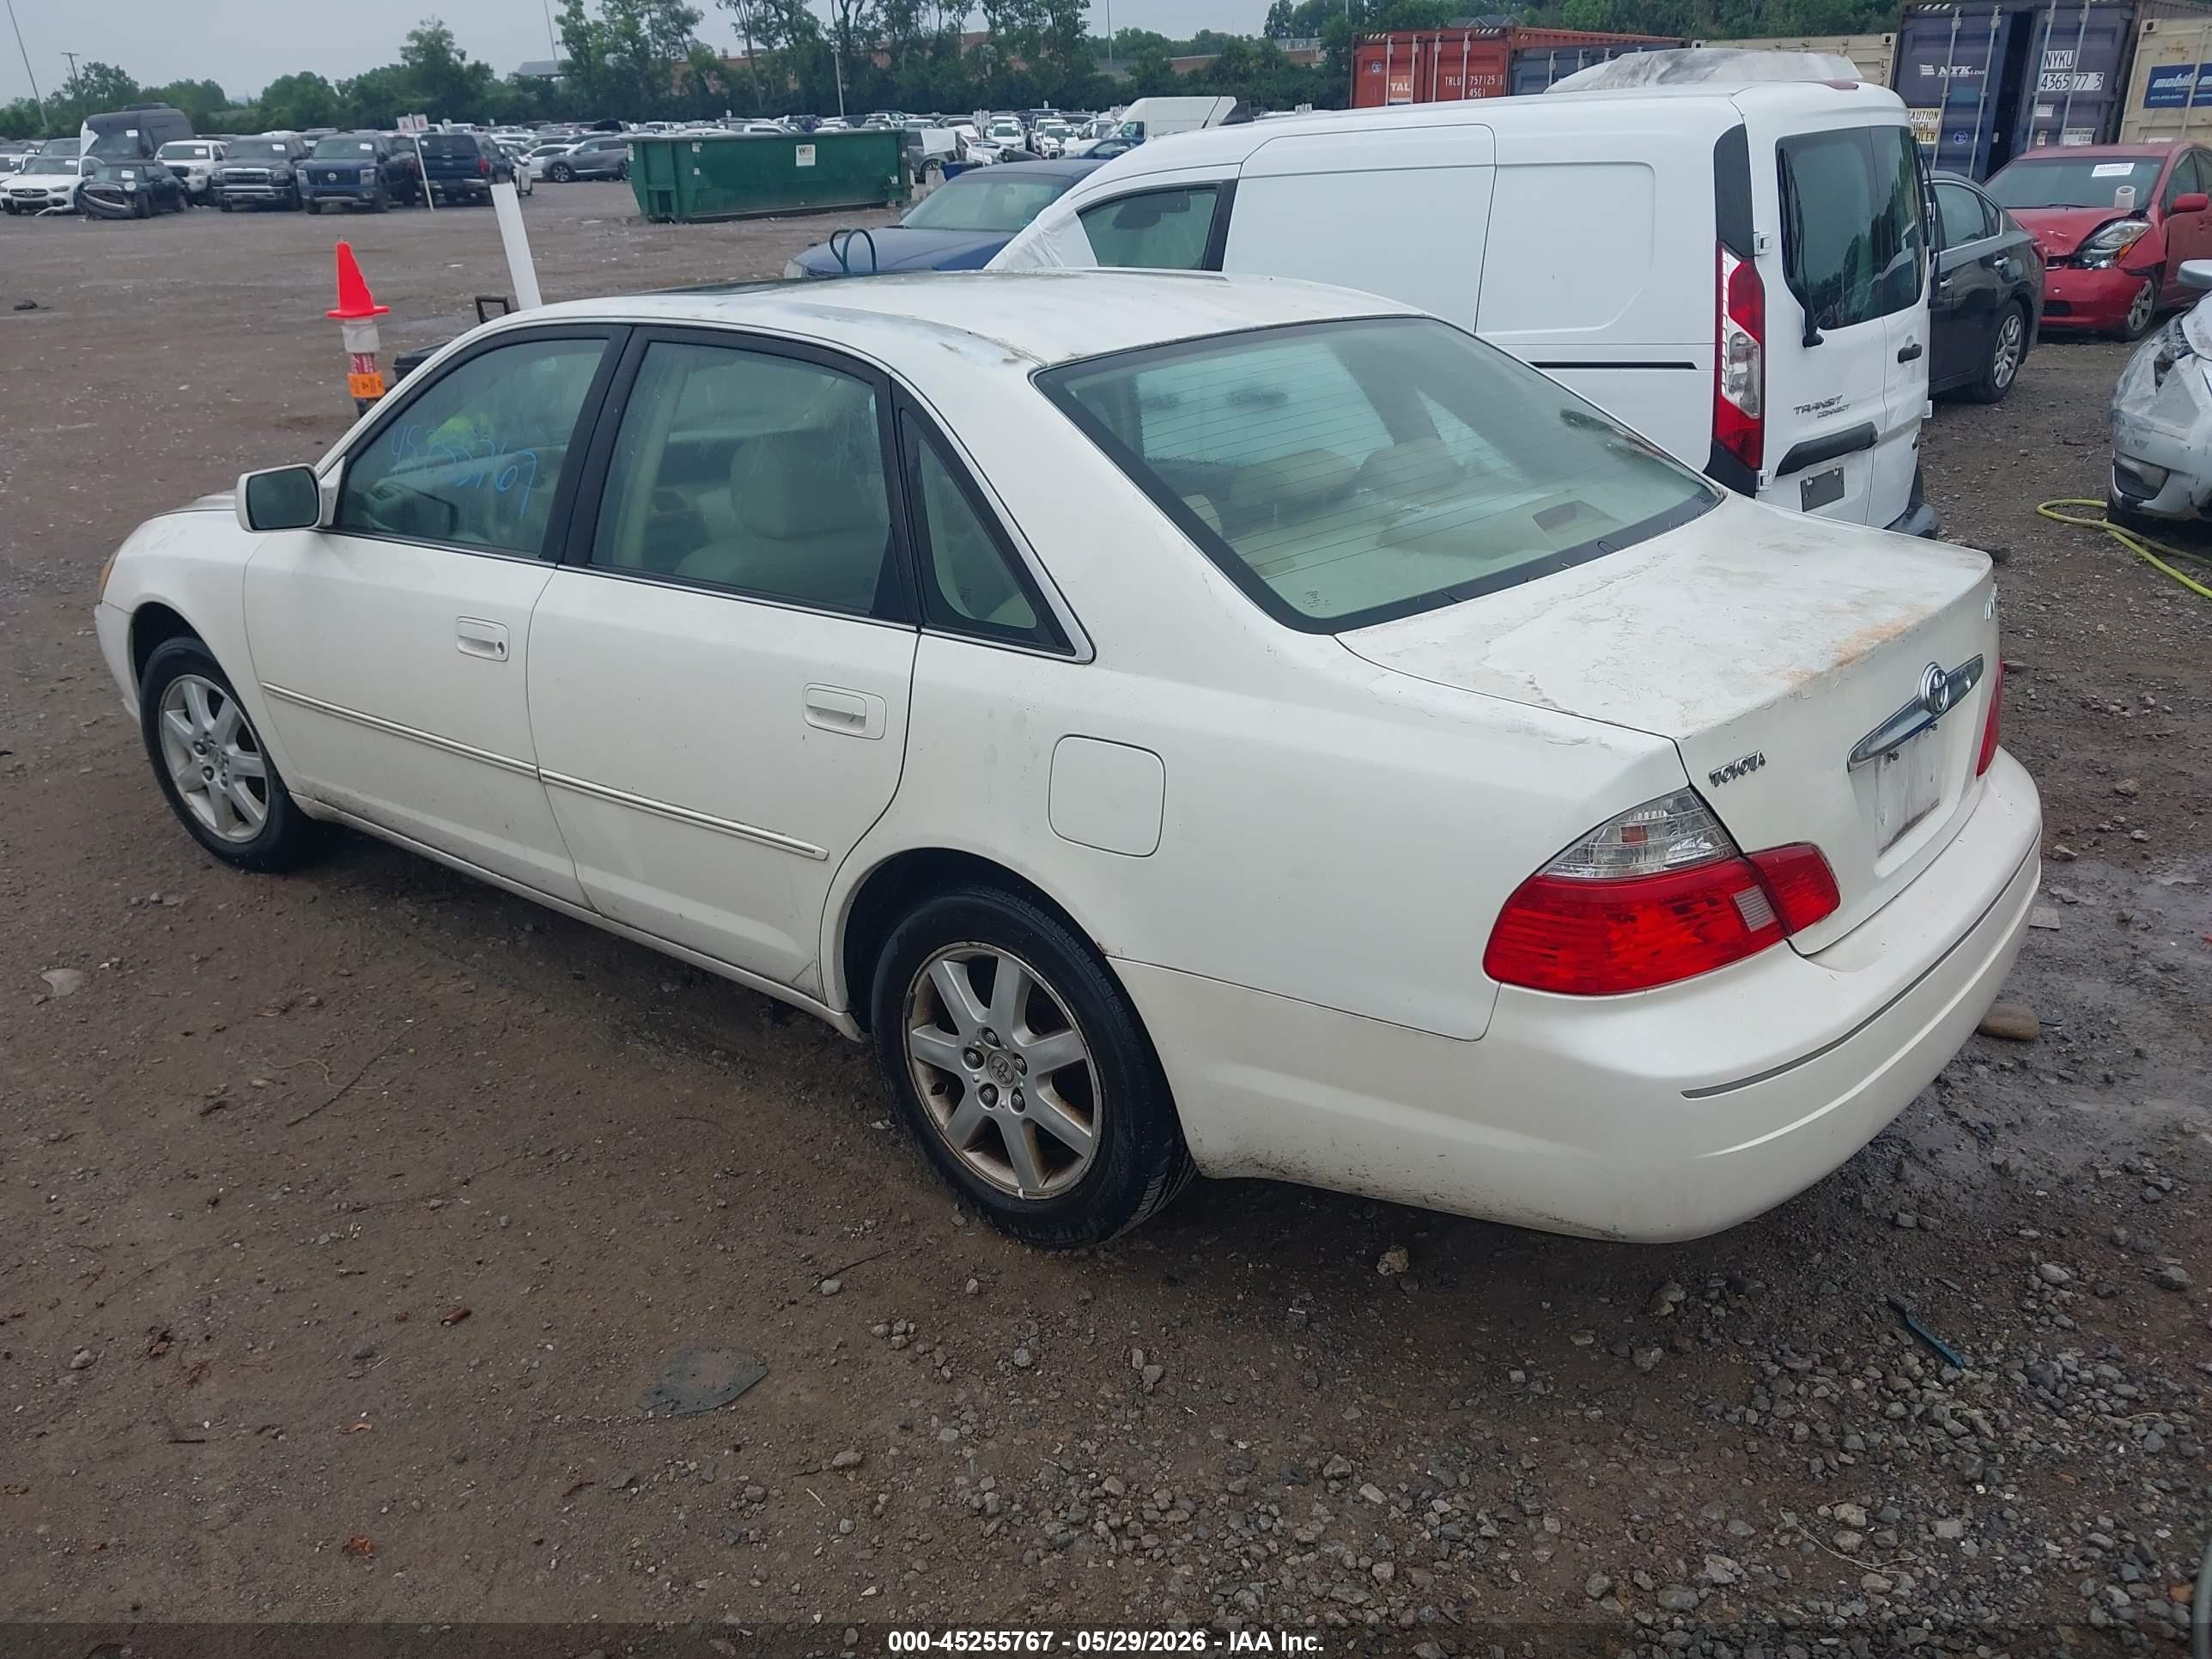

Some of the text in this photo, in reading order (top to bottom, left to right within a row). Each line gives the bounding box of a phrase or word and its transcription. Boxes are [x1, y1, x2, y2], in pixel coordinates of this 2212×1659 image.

[2044, 52, 2075, 68] NYKU
[1937, 66, 1972, 77] NYK
[1390, 82, 1411, 91] TAL
[1445, 76, 1462, 86] TRLU
[1470, 75, 1495, 85] 757125
[2041, 74, 2103, 89] 436577 3
[2153, 72, 2196, 88] mobil
[1469, 88, 1486, 97] 45G1
[1910, 111, 1939, 120] AUTION
[1793, 394, 1843, 415] TRANSIT
[1709, 750, 1765, 787] TOYOTA
